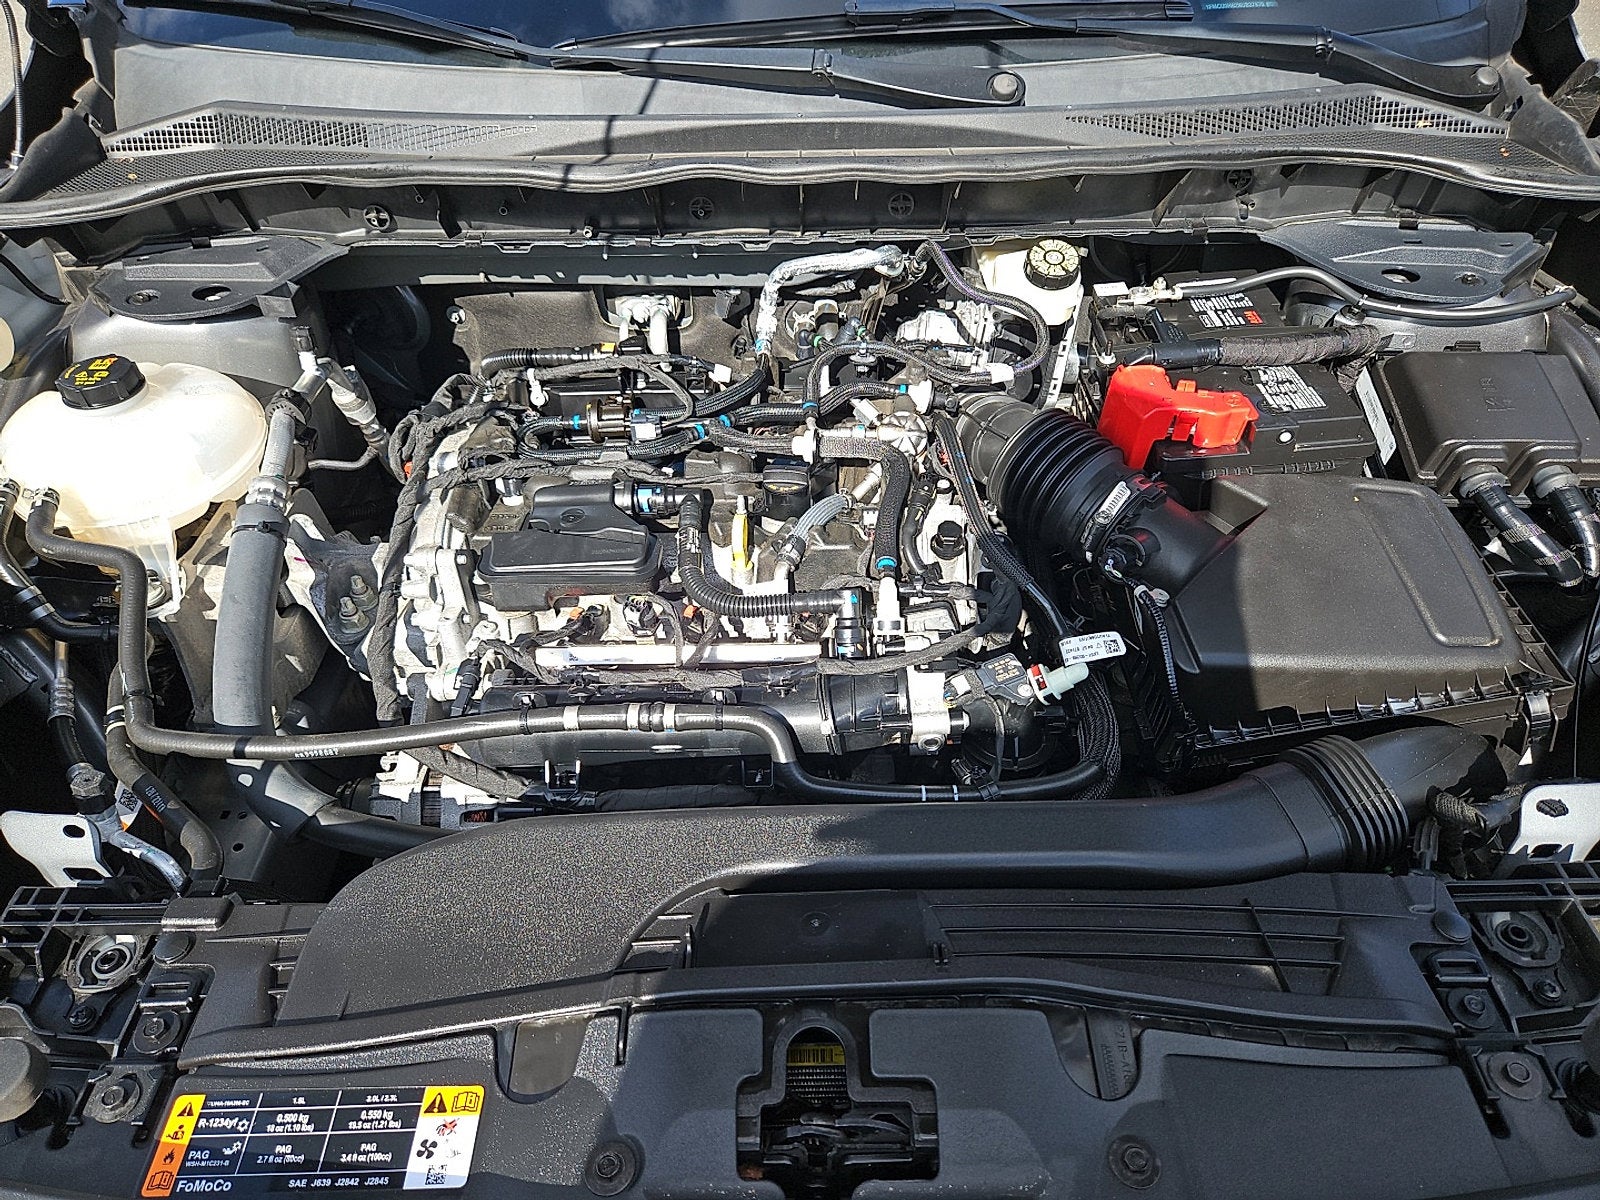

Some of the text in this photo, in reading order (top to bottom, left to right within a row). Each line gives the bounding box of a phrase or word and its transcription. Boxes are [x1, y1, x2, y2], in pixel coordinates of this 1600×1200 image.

[276, 1113, 310, 1124] 0.500 kg
[360, 1110, 394, 1121] 0.550 kg
[275, 1145, 292, 1154] PAG
[360, 1143, 377, 1152] PAG
[188, 1150, 210, 1160] PAG
[256, 1155, 267, 1164] 2.7
[175, 1179, 232, 1193] FoMoCo
[288, 1176, 389, 1188] SAE J639 J2842 J2845
